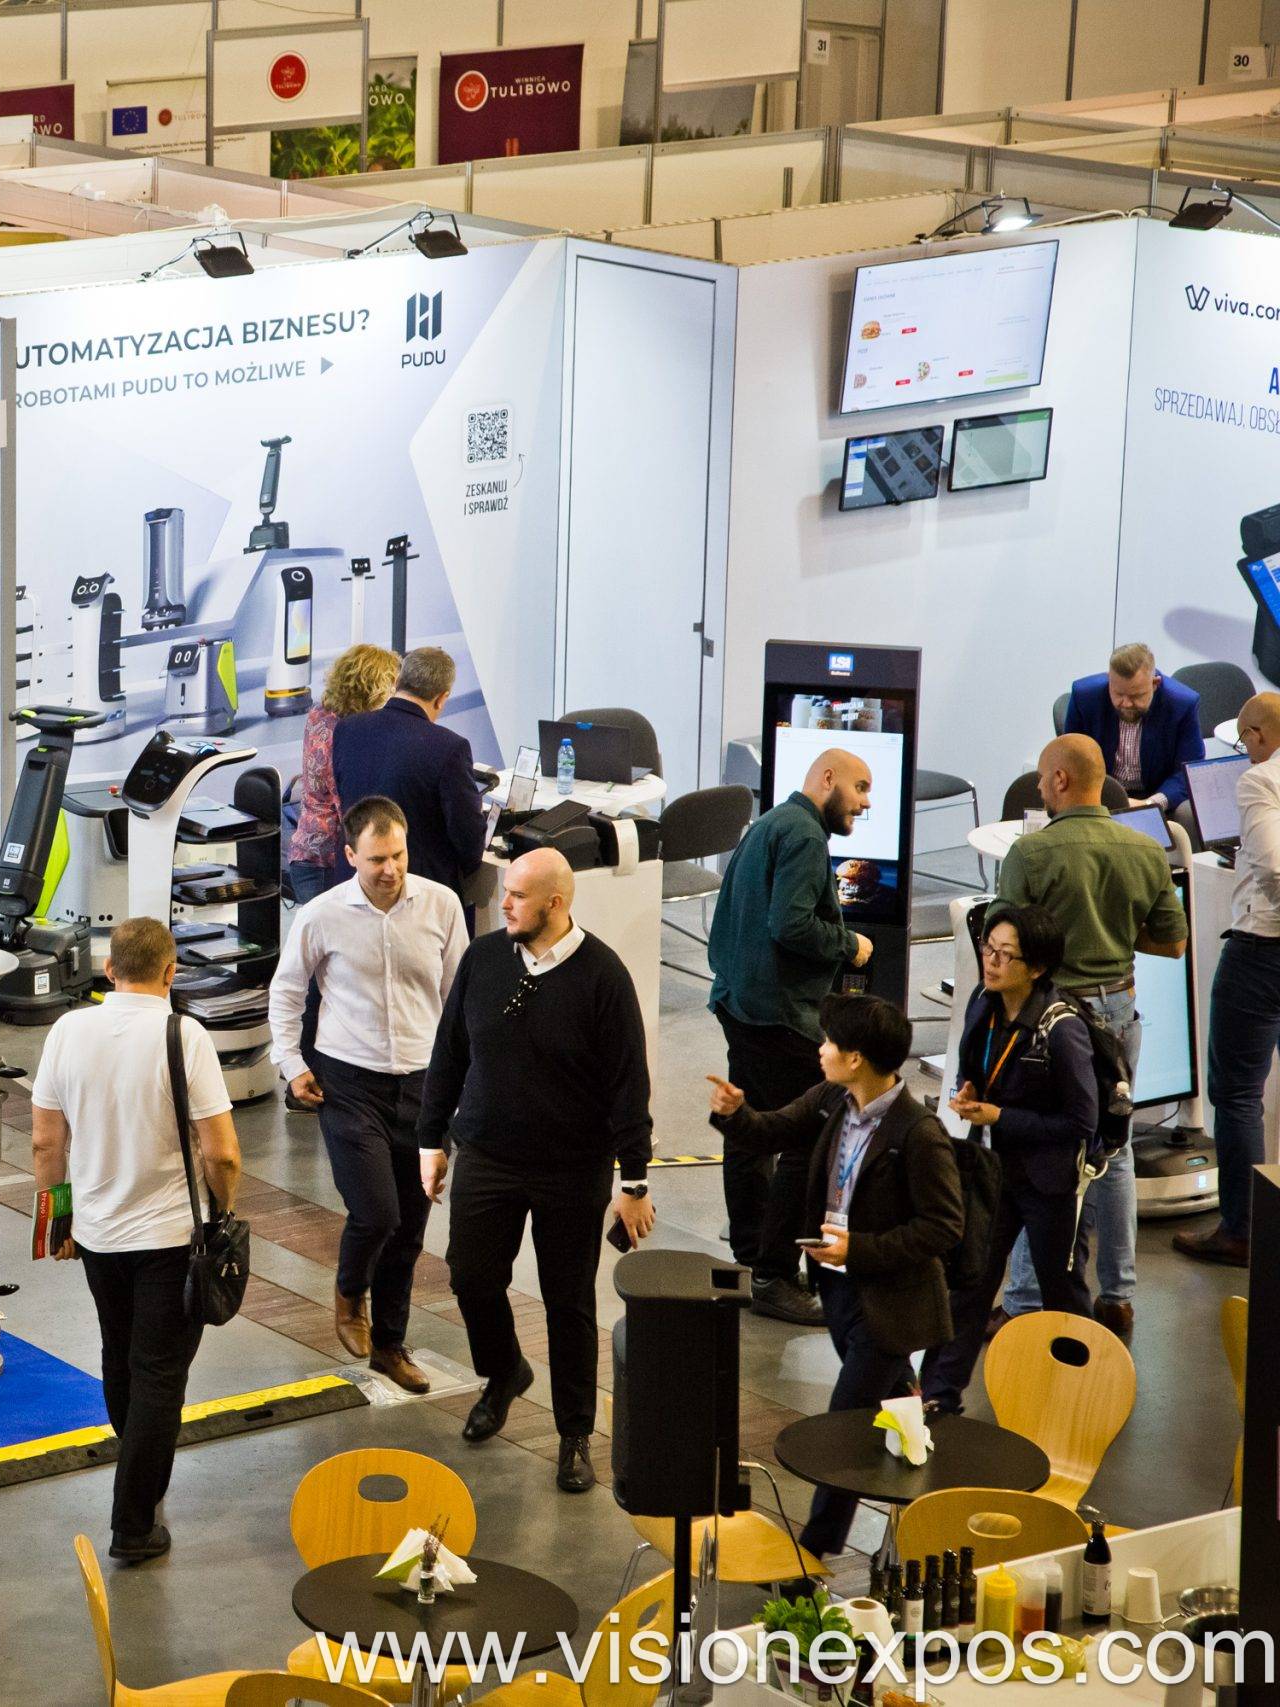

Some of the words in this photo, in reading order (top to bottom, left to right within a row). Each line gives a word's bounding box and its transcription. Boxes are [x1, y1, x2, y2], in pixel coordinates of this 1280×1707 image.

[817, 39, 827, 51] 31
[1233, 54, 1250, 67] 30
[490, 80, 570, 98] TULIBOWO
[1214, 293, 1280, 320] viva.co
[242, 309, 371, 345] BIZNESU?
[401, 349, 447, 369] PUDU
[123, 374, 177, 397] PUDU
[183, 371, 209, 391] TO
[215, 359, 307, 386] MOŻLIWE
[466, 480, 508, 497] ZESKANUJ
[468, 495, 509, 515] SPRAWDŹ
